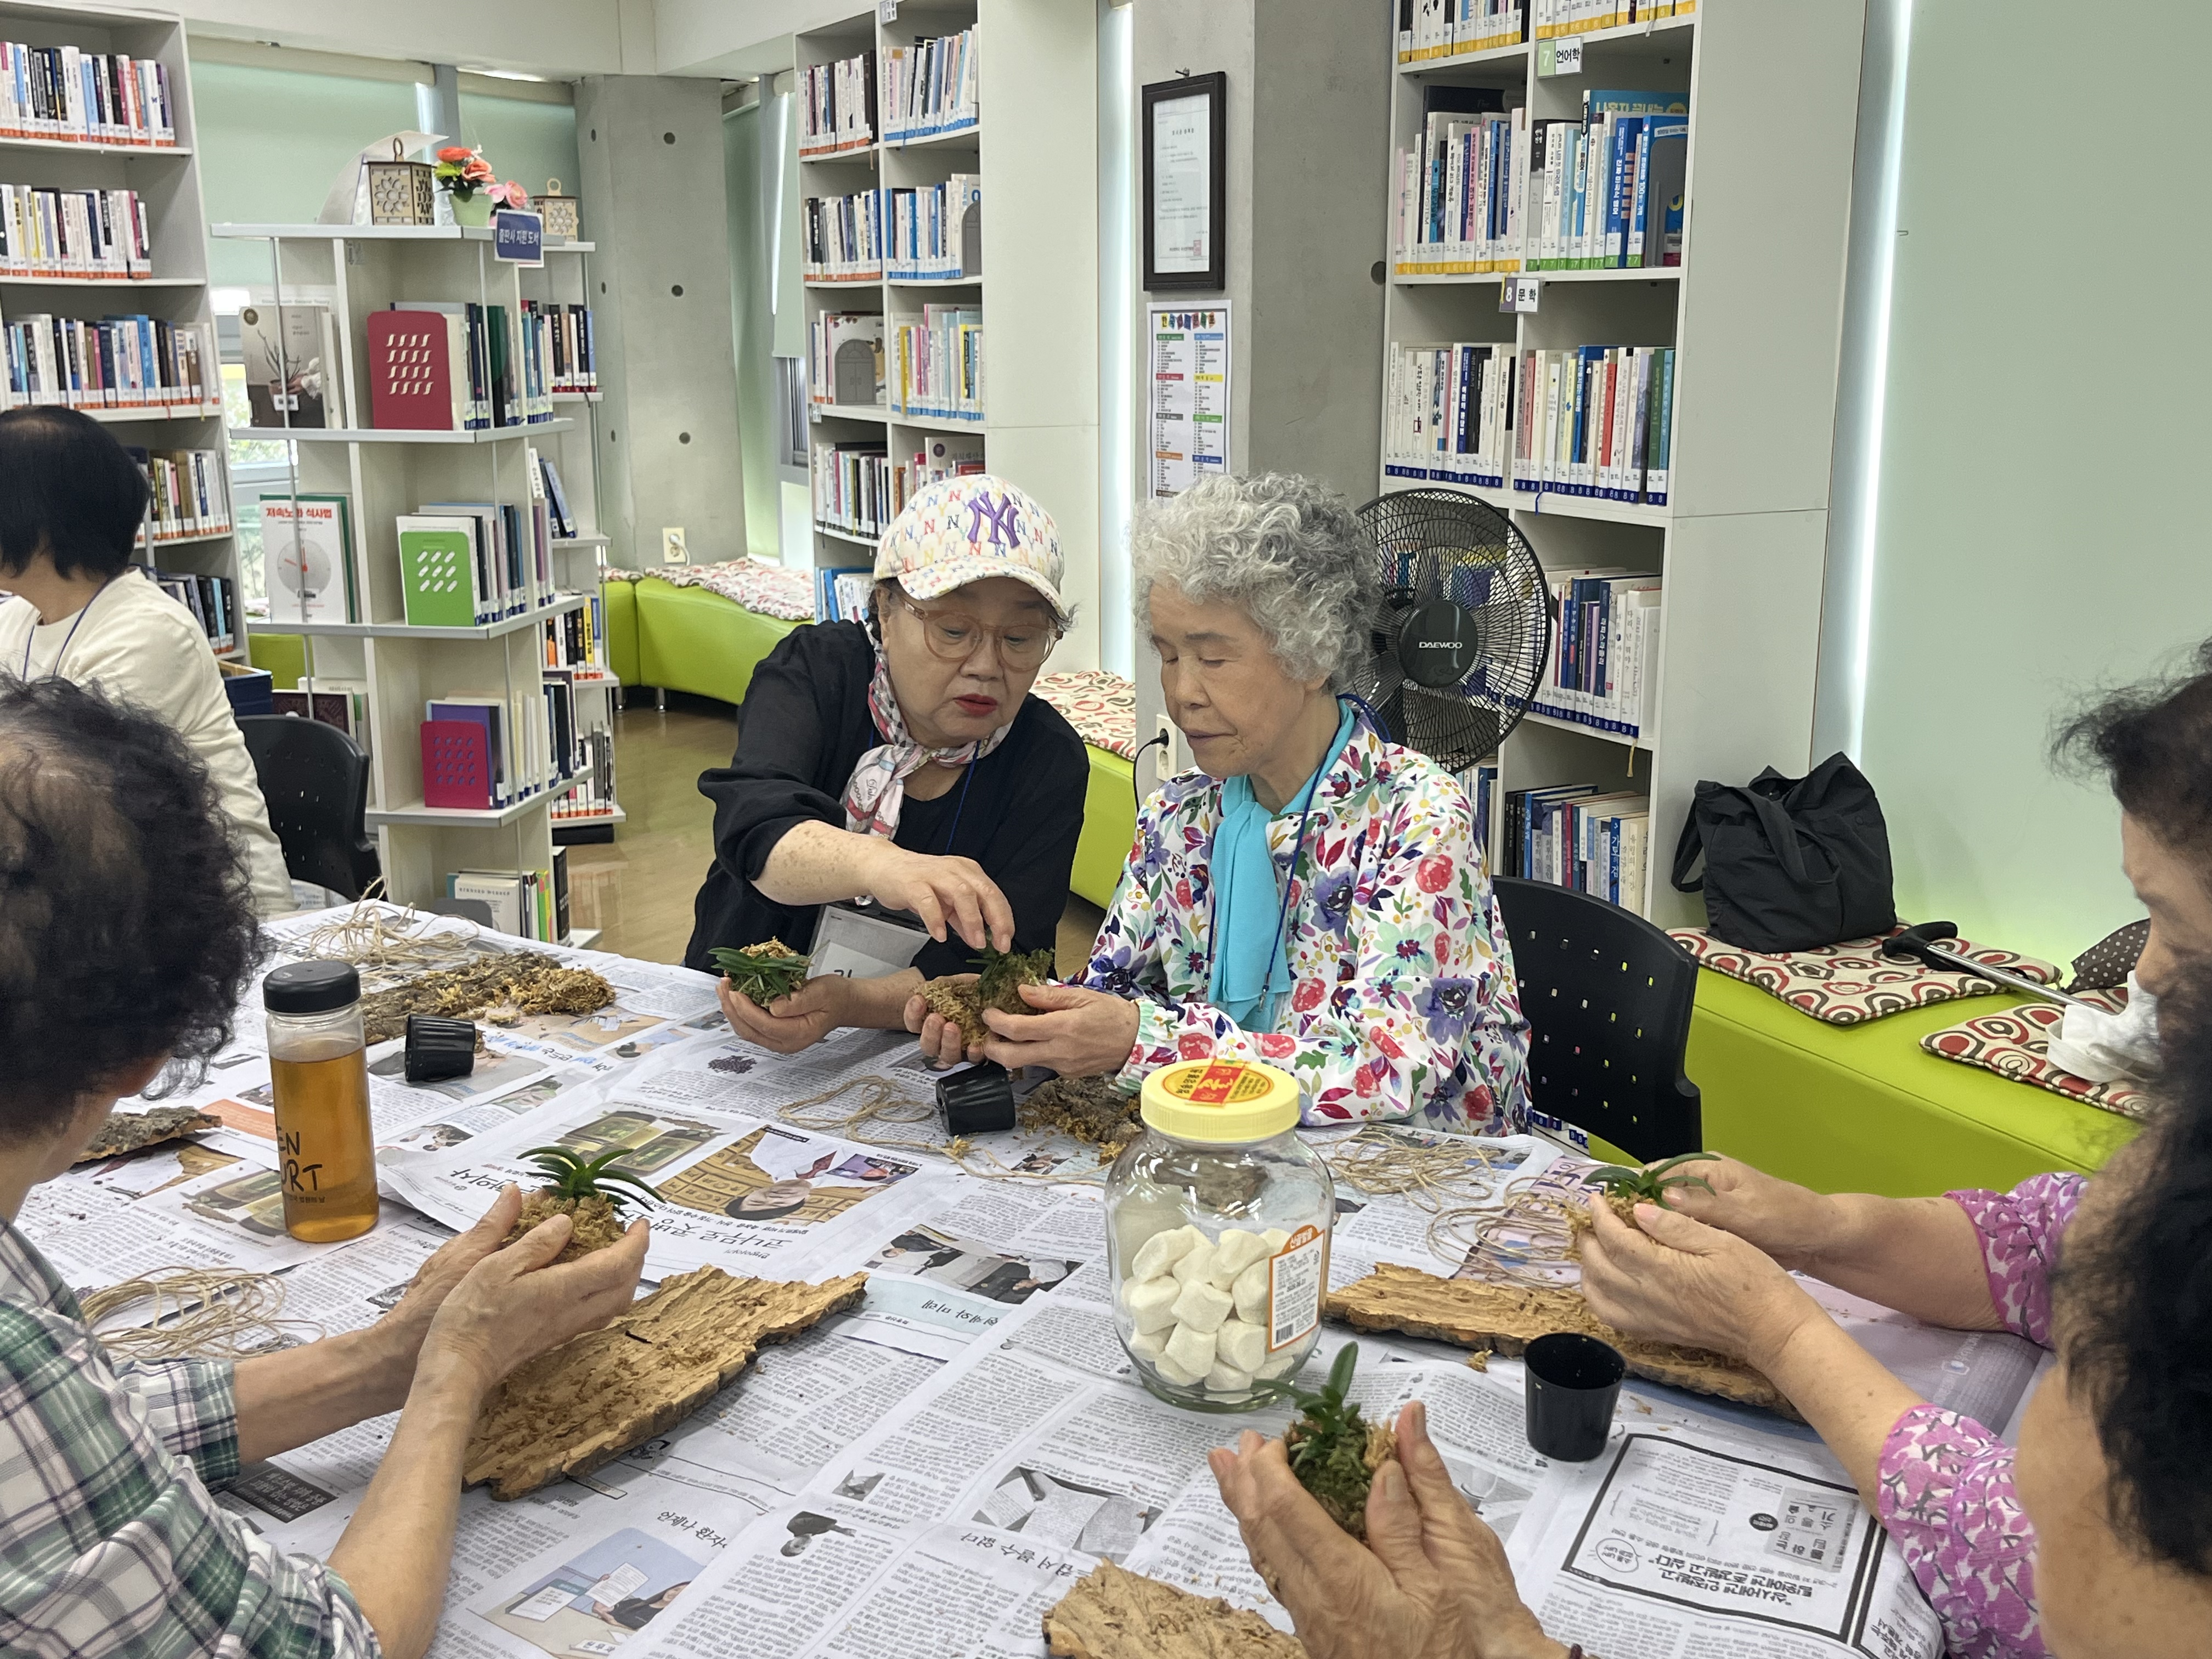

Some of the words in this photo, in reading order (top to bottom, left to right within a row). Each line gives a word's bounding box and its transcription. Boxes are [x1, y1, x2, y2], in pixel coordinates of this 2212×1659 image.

[1543, 50, 1550, 66] 7
[1556, 48, 1580, 63] 언어학
[1615, 159, 1622, 174] 진짜
[1613, 176, 1621, 199] 미국식
[1505, 287, 1513, 302] 8
[949, 490, 962, 501] N
[306, 508, 332, 518] 식사법
[938, 504, 947, 516] Y
[924, 519, 935, 535] N
[947, 515, 960, 529] N
[967, 491, 1020, 549] NY
[1017, 520, 1026, 535] N
[959, 527, 969, 540] Y
[969, 541, 982, 555] N
[995, 543, 1006, 557] N
[699, 1230, 792, 1249] 코나무로
[921, 1299, 952, 1314] 미래
[656, 1510, 698, 1531] 언제나
[960, 1533, 996, 1549] 없다
[1688, 1562, 1748, 1583] 존경받고
[1750, 1574, 1812, 1597] 팀원에겐
